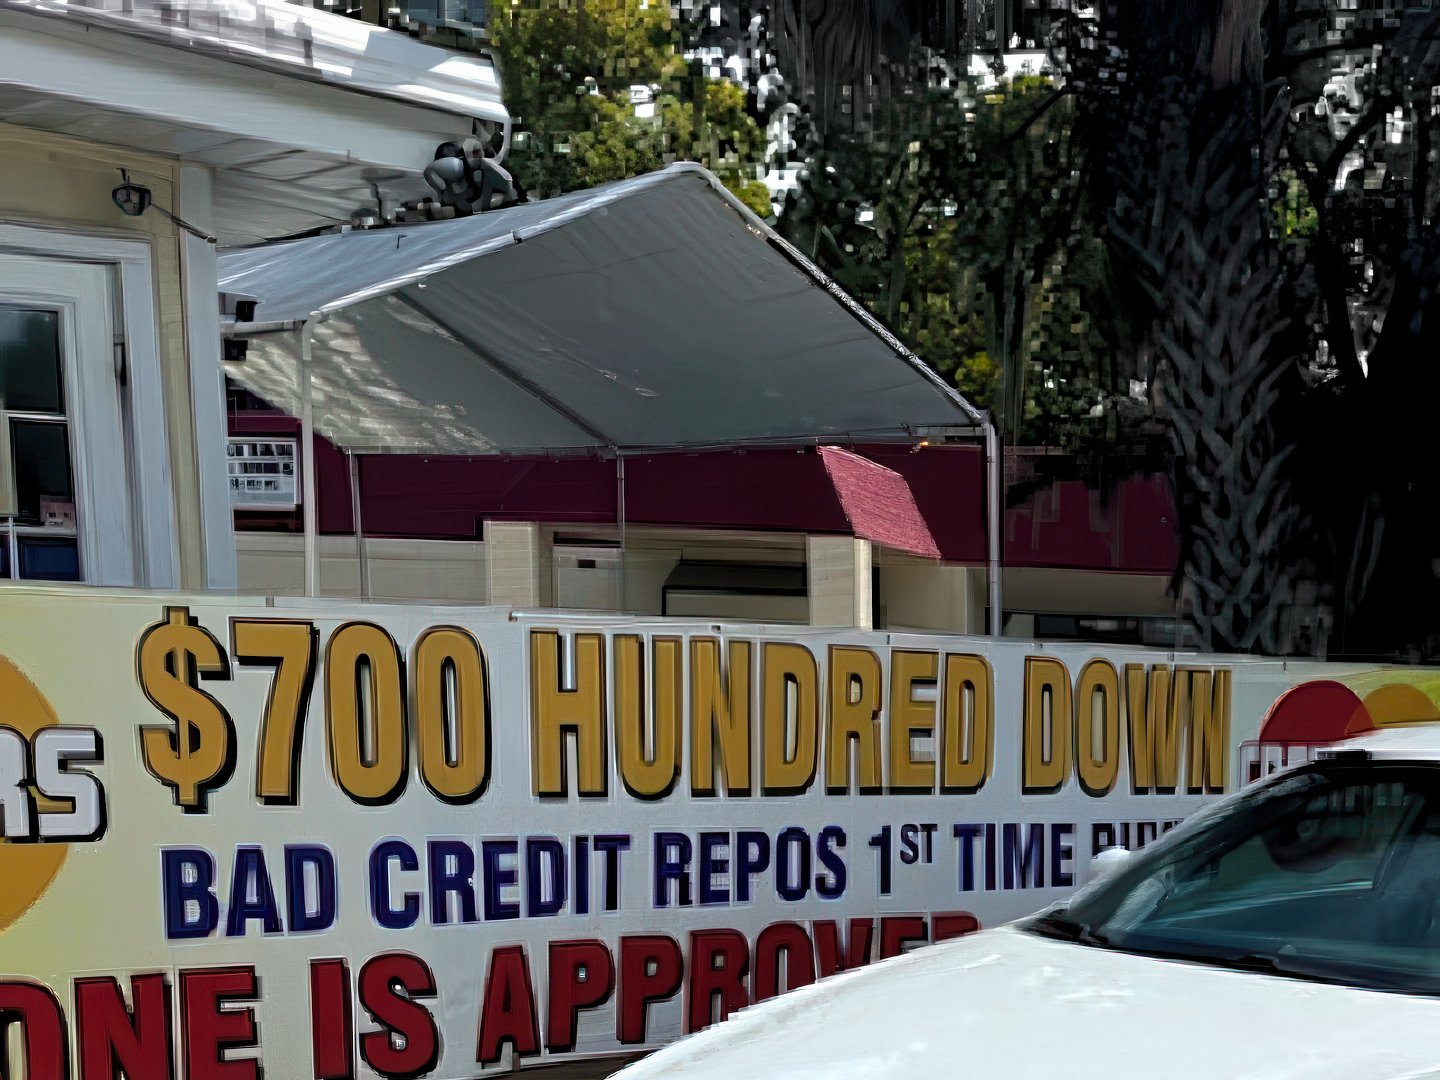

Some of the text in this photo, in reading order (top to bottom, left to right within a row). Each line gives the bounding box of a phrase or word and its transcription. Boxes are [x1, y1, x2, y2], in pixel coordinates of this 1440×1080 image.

[136, 606, 1231, 814] $700 HUNDRED DOWN
[160, 843, 338, 940] BAD
[368, 834, 630, 930] CREDIT
[652, 825, 848, 909] REPOS
[954, 821, 1074, 892] TIME
[476, 911, 982, 1064] APPROV
